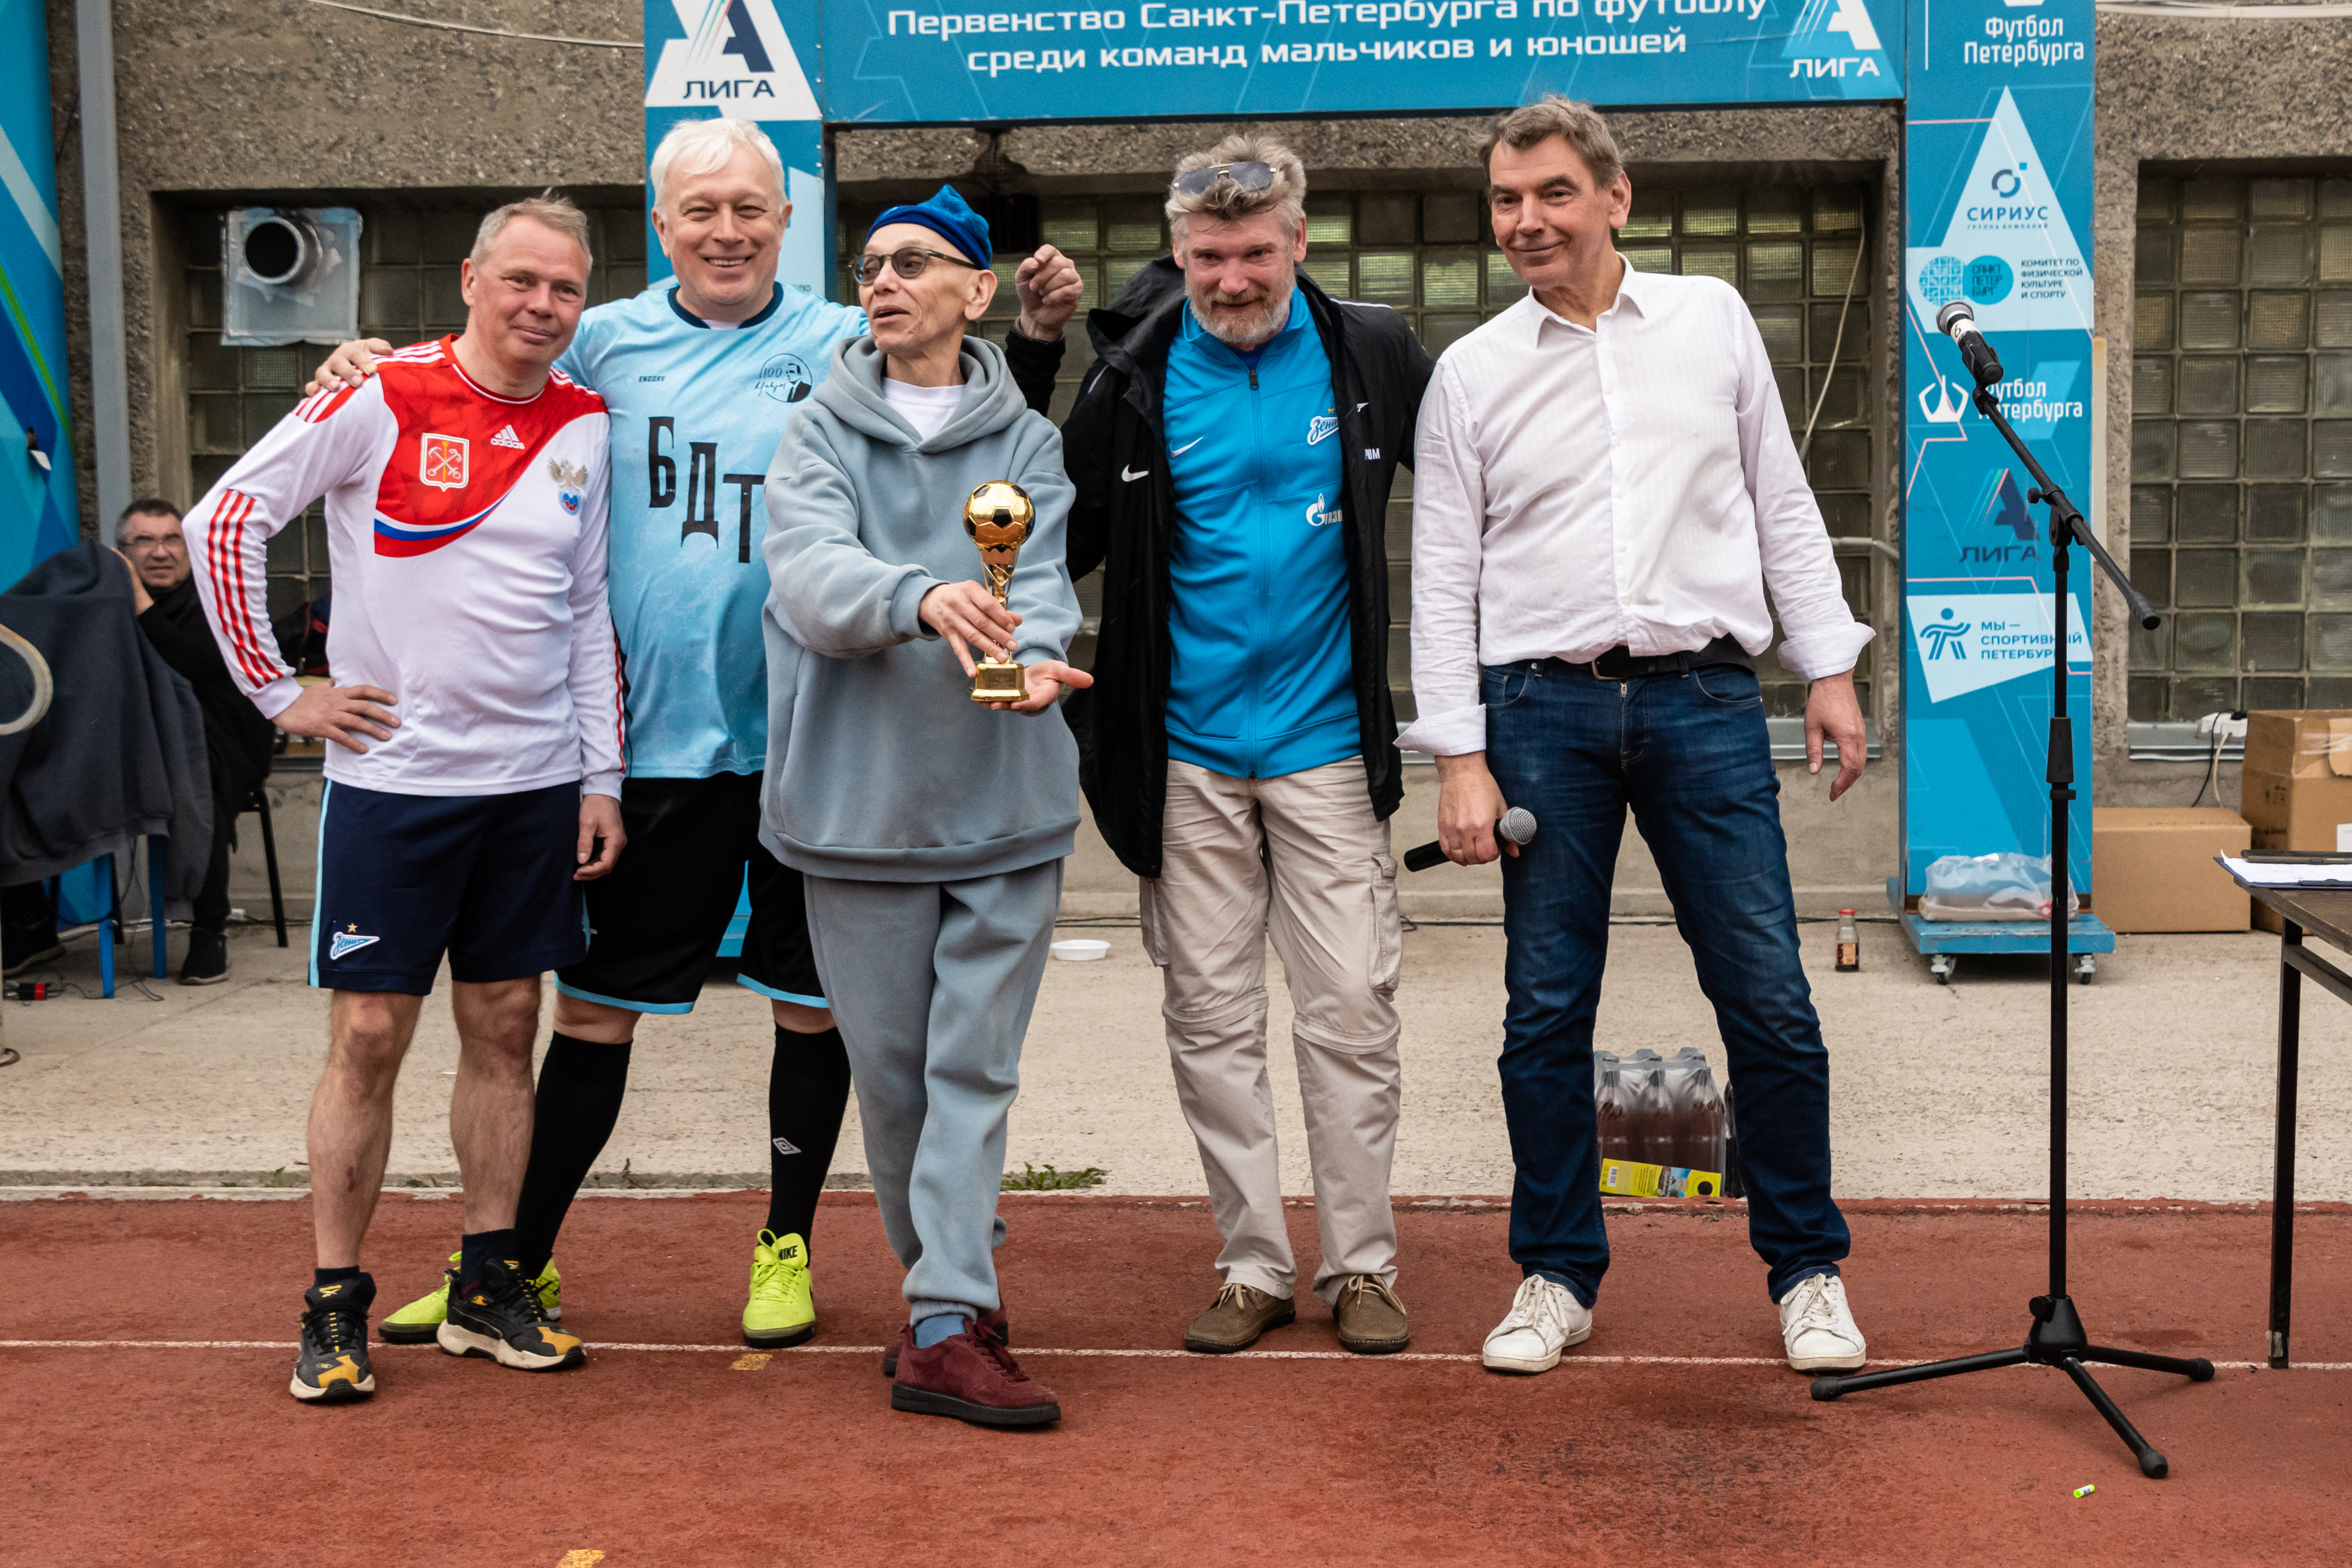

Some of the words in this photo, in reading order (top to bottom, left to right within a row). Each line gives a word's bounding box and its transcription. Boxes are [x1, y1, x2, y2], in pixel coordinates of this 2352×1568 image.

[889, 10, 1126, 41] Первенство
[1140, 0, 1518, 29] Санкт-Петербурга
[1533, 0, 1579, 17] по
[1986, 14, 2064, 43] Футбол
[968, 49, 1086, 78] среди
[1100, 45, 1248, 68] команд
[1262, 39, 1474, 63] мальчиков
[1490, 38, 1512, 57] и
[1528, 26, 1686, 56] юношей
[1964, 39, 2084, 67] Петербурга
[1790, 58, 1880, 78] ЛИГА
[683, 80, 775, 99] ЛИГА
[1967, 206, 2048, 221] СИРИУС
[2021, 267, 2082, 277] ФИЗИЧЕСКОЙ
[2021, 280, 2063, 288] КУЛЬТУРЕ
[2030, 290, 2066, 299] СПОРТУ
[763, 367, 783, 378] 100
[1978, 398, 2083, 423] тербурга
[490, 438, 525, 450] adidas
[648, 416, 765, 564] БДТ
[1960, 546, 2041, 562] ЛИГА
[1981, 621, 2005, 631] МЫ
